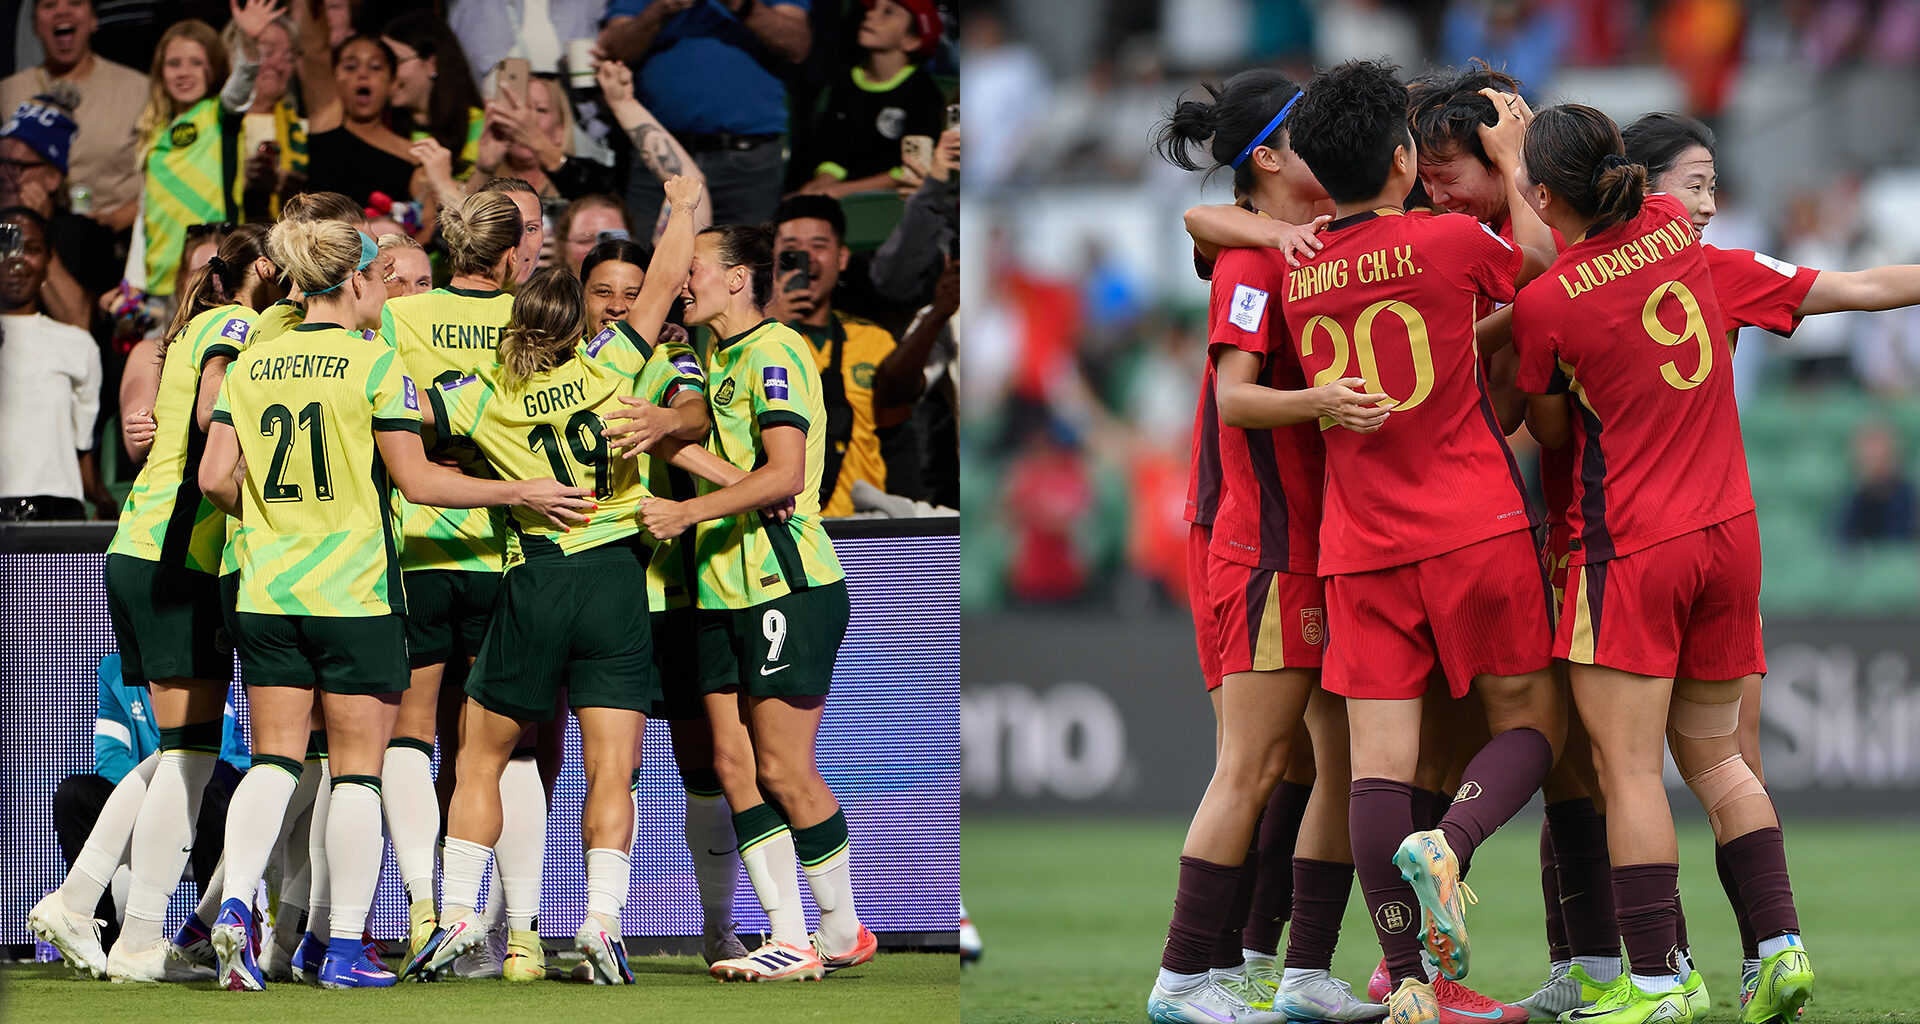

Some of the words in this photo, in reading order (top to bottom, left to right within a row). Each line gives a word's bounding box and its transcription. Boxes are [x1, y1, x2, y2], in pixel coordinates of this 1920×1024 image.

[1288, 258, 1348, 303] ZHANG
[1356, 244, 1424, 284] CH.X.
[250, 354, 350, 381] CARPENTER
[1301, 299, 1435, 431] 20
[1641, 280, 1713, 390] 9
[523, 377, 586, 418] GORRY
[260, 401, 334, 503] 21
[527, 409, 614, 502] 19
[762, 609, 787, 662] 9
